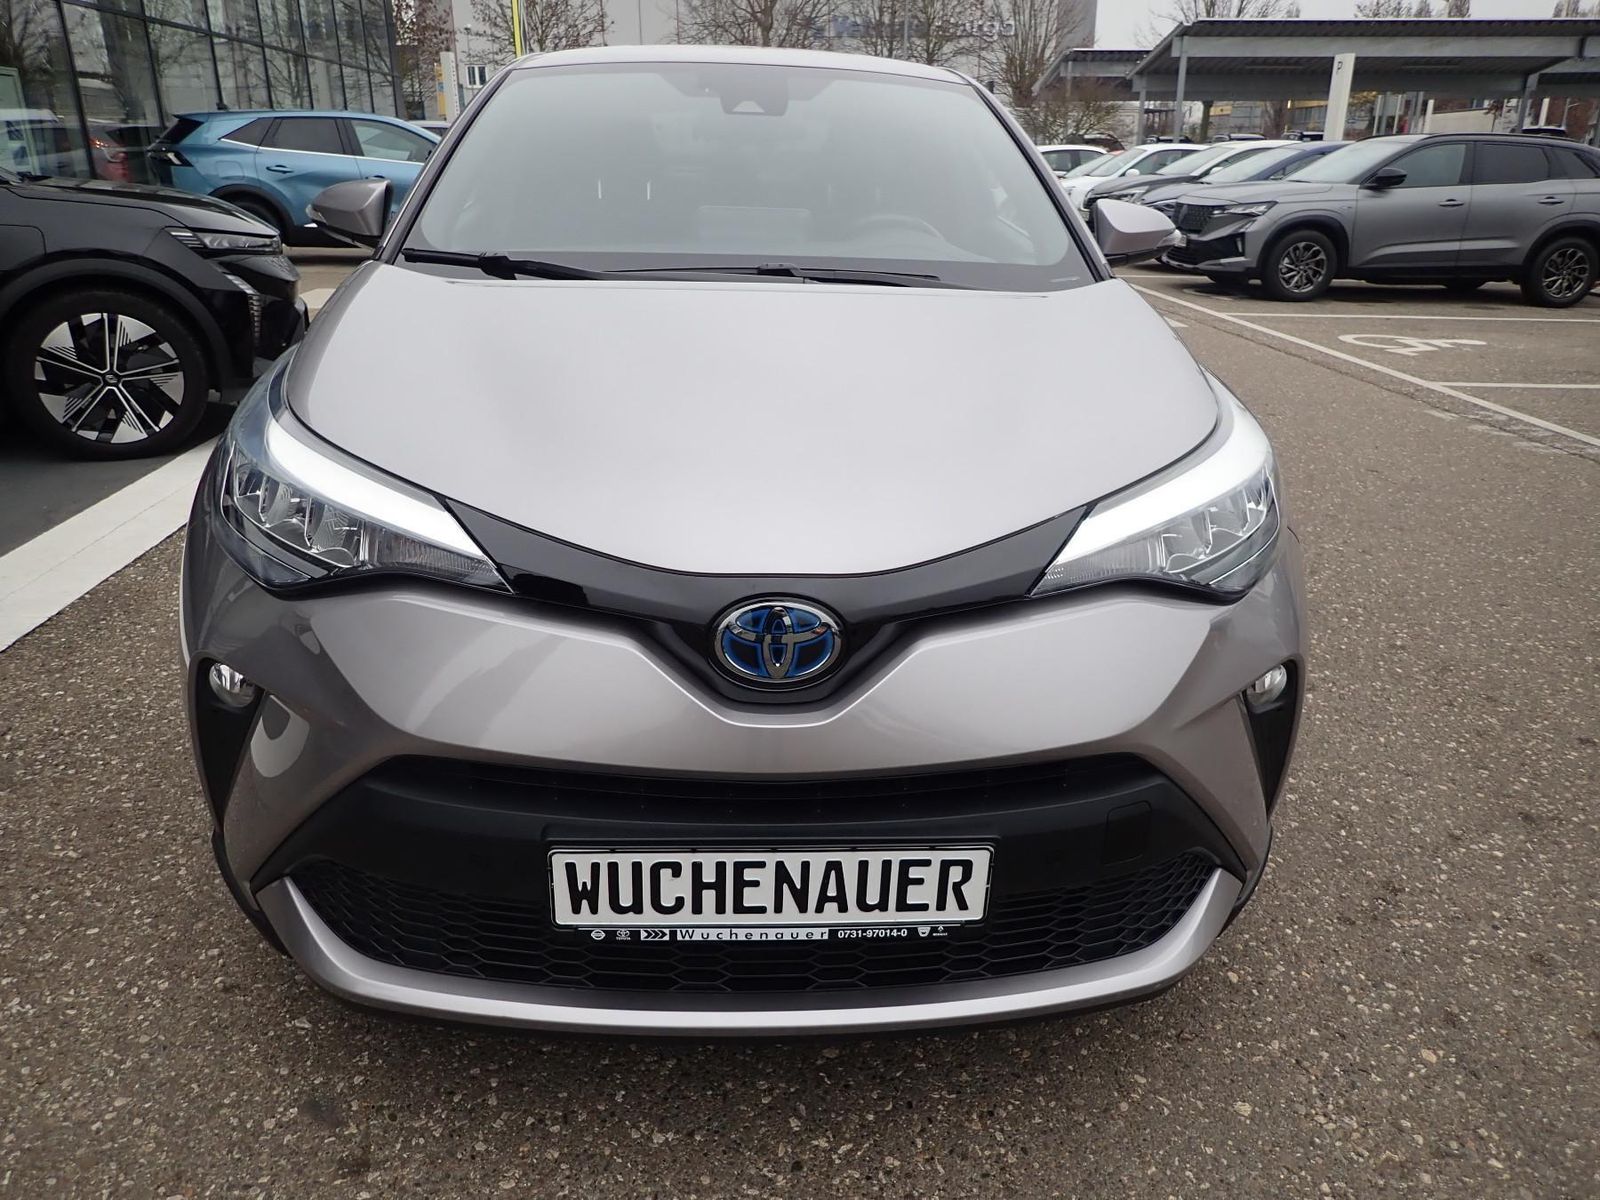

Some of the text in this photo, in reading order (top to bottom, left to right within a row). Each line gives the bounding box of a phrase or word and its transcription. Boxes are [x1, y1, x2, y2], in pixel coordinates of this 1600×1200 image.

[564, 858, 974, 915] WUCHENAUER
[679, 928, 908, 940] Wuchenauer 0731-97014-0
